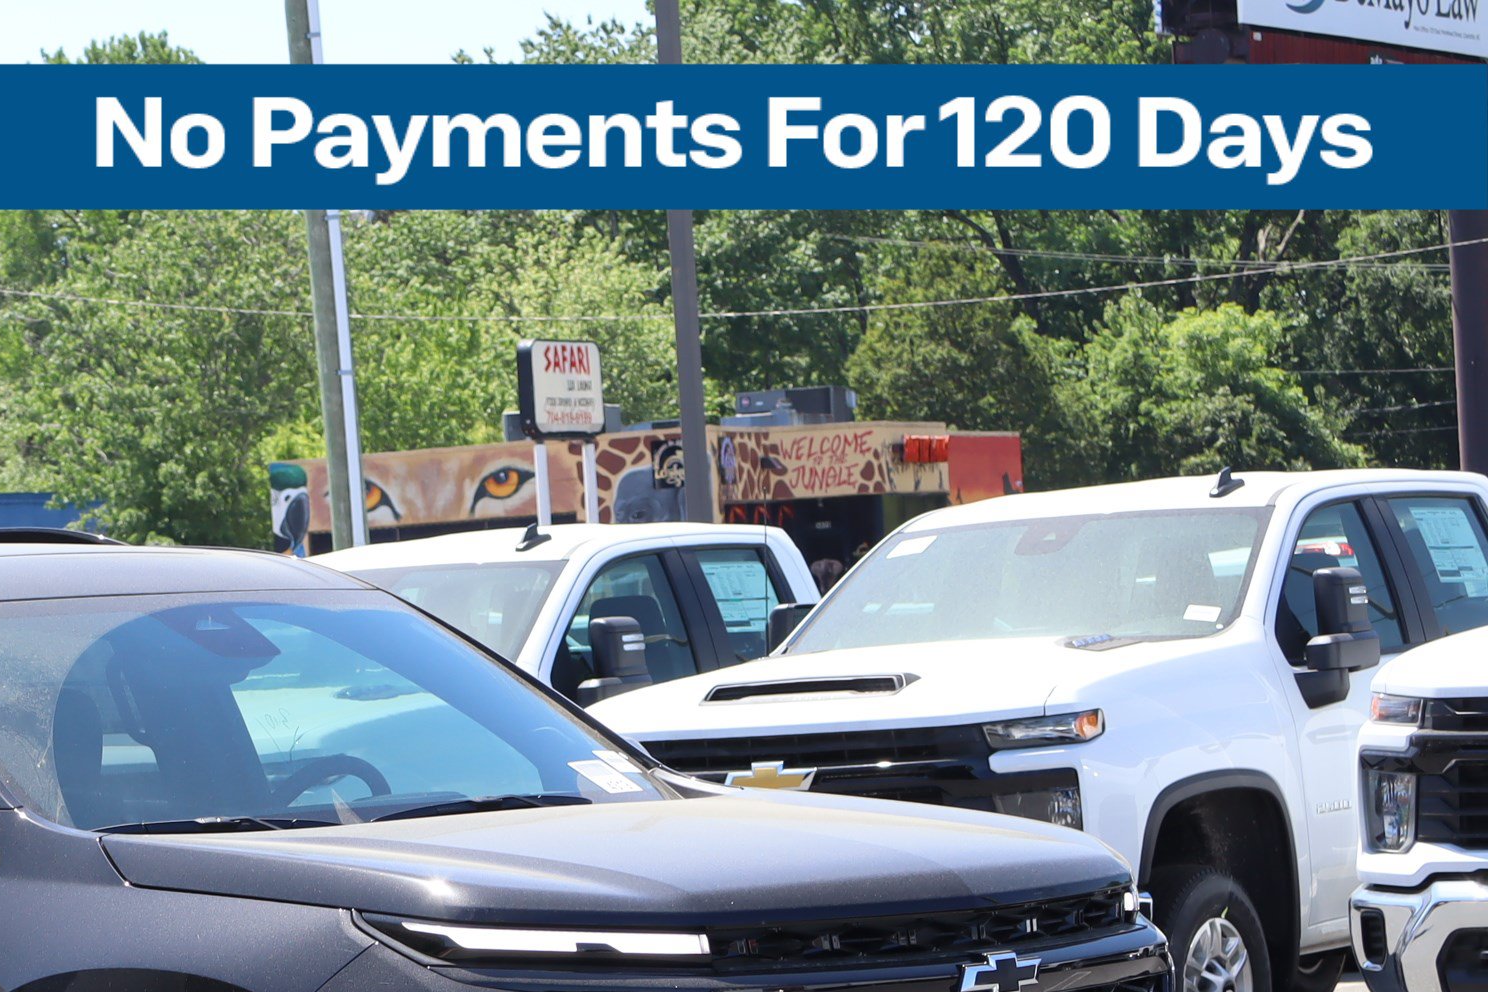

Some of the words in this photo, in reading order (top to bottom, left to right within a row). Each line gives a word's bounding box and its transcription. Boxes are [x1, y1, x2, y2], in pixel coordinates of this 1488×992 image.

[544, 344, 591, 376] SAFARI
[779, 430, 874, 460] WELCOME
[789, 463, 859, 494] JUNGLE
